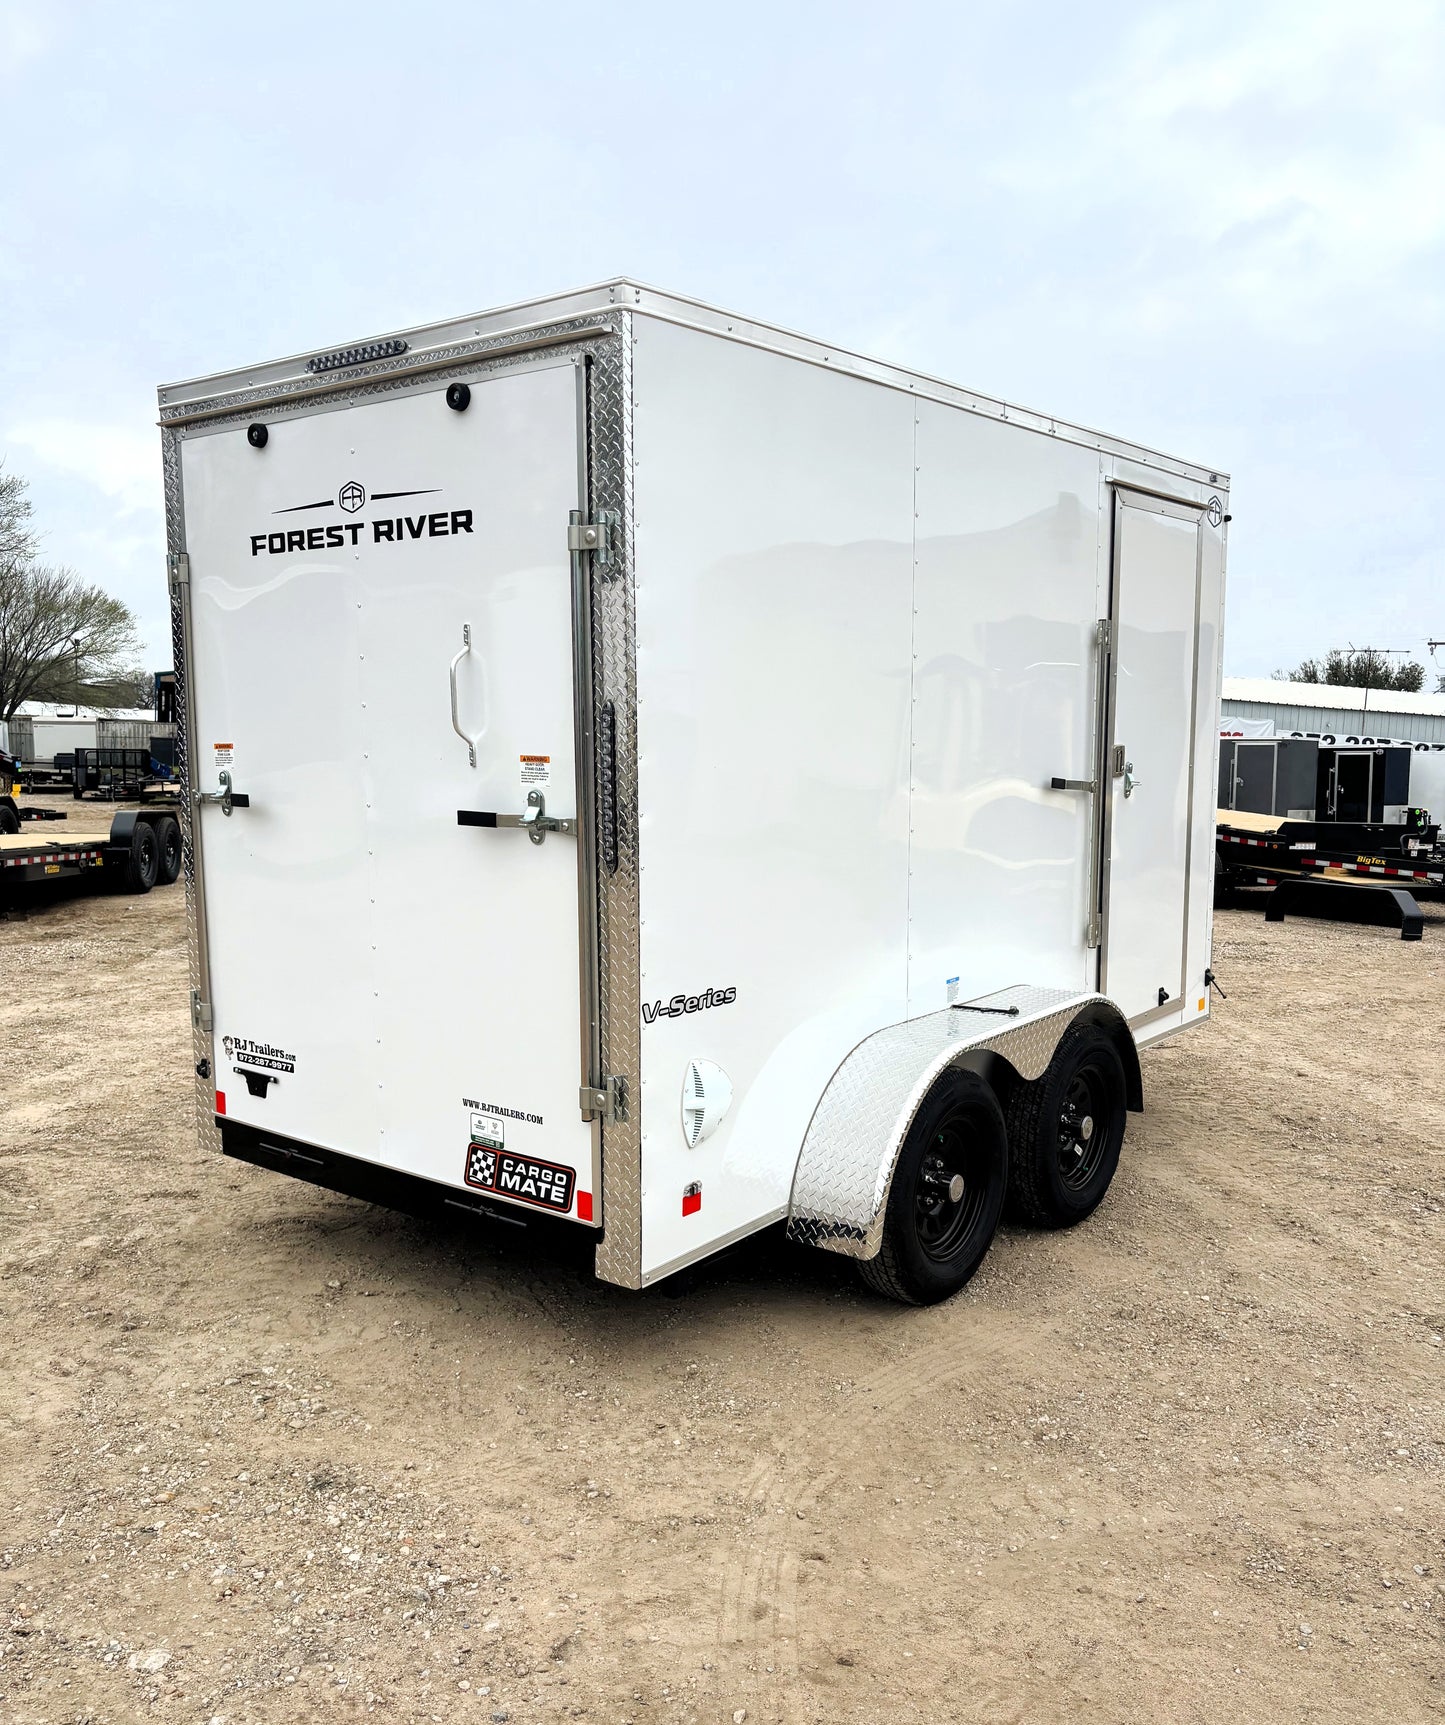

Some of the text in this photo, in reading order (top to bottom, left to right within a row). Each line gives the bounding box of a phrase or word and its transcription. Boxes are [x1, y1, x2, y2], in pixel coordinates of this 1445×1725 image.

[250, 509, 474, 556] FOREST RIVER
[642, 987, 736, 1024] V-Series
[233, 1037, 247, 1051] RJ
[238, 1053, 292, 1072] 972-287-9977
[462, 1098, 543, 1125] WWW.RJTRAILERS.COM
[503, 1159, 567, 1186] CARGO
[500, 1172, 566, 1203] MATE
